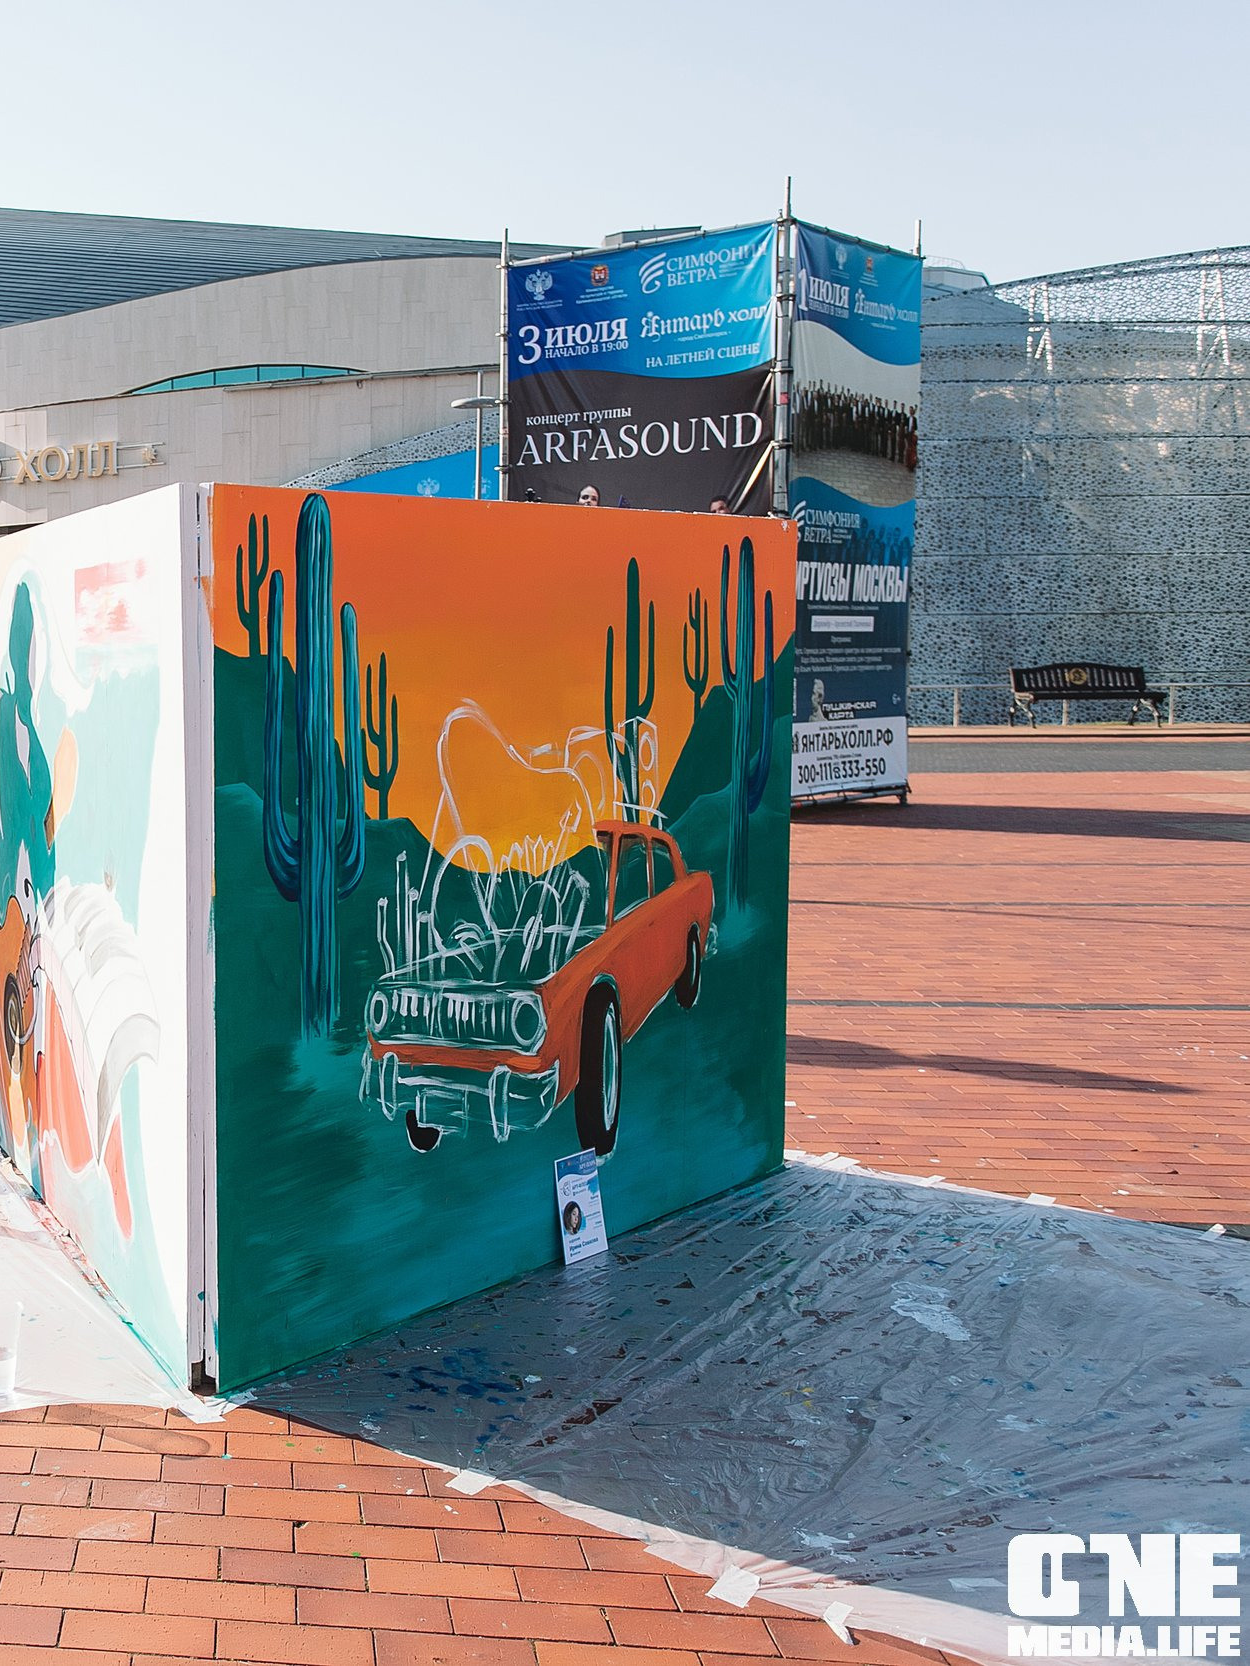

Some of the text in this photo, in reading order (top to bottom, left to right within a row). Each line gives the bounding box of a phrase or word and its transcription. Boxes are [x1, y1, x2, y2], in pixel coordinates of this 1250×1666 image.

[667, 266, 717, 287] ВЕТРА
[798, 267, 850, 312] 1 ИЮЛЯ
[518, 317, 628, 364] 3 ИЮЛЯ
[545, 340, 629, 359] НАЧАЛО В 19:00
[646, 342, 761, 368] НА ЛЕТНЕЙ СЦЕНЕ
[526, 407, 632, 427] концерт группы
[516, 411, 763, 466] ARFASOUND
[805, 508, 861, 529] СИМФОНИЯ
[803, 526, 833, 544] ВЕТРА
[796, 560, 909, 603] ИРТУОЗЫ МОСКВЫ
[802, 728, 894, 754] ЯНТАРЬХОЛЛ.РФ
[840, 756, 887, 779] 333-550
